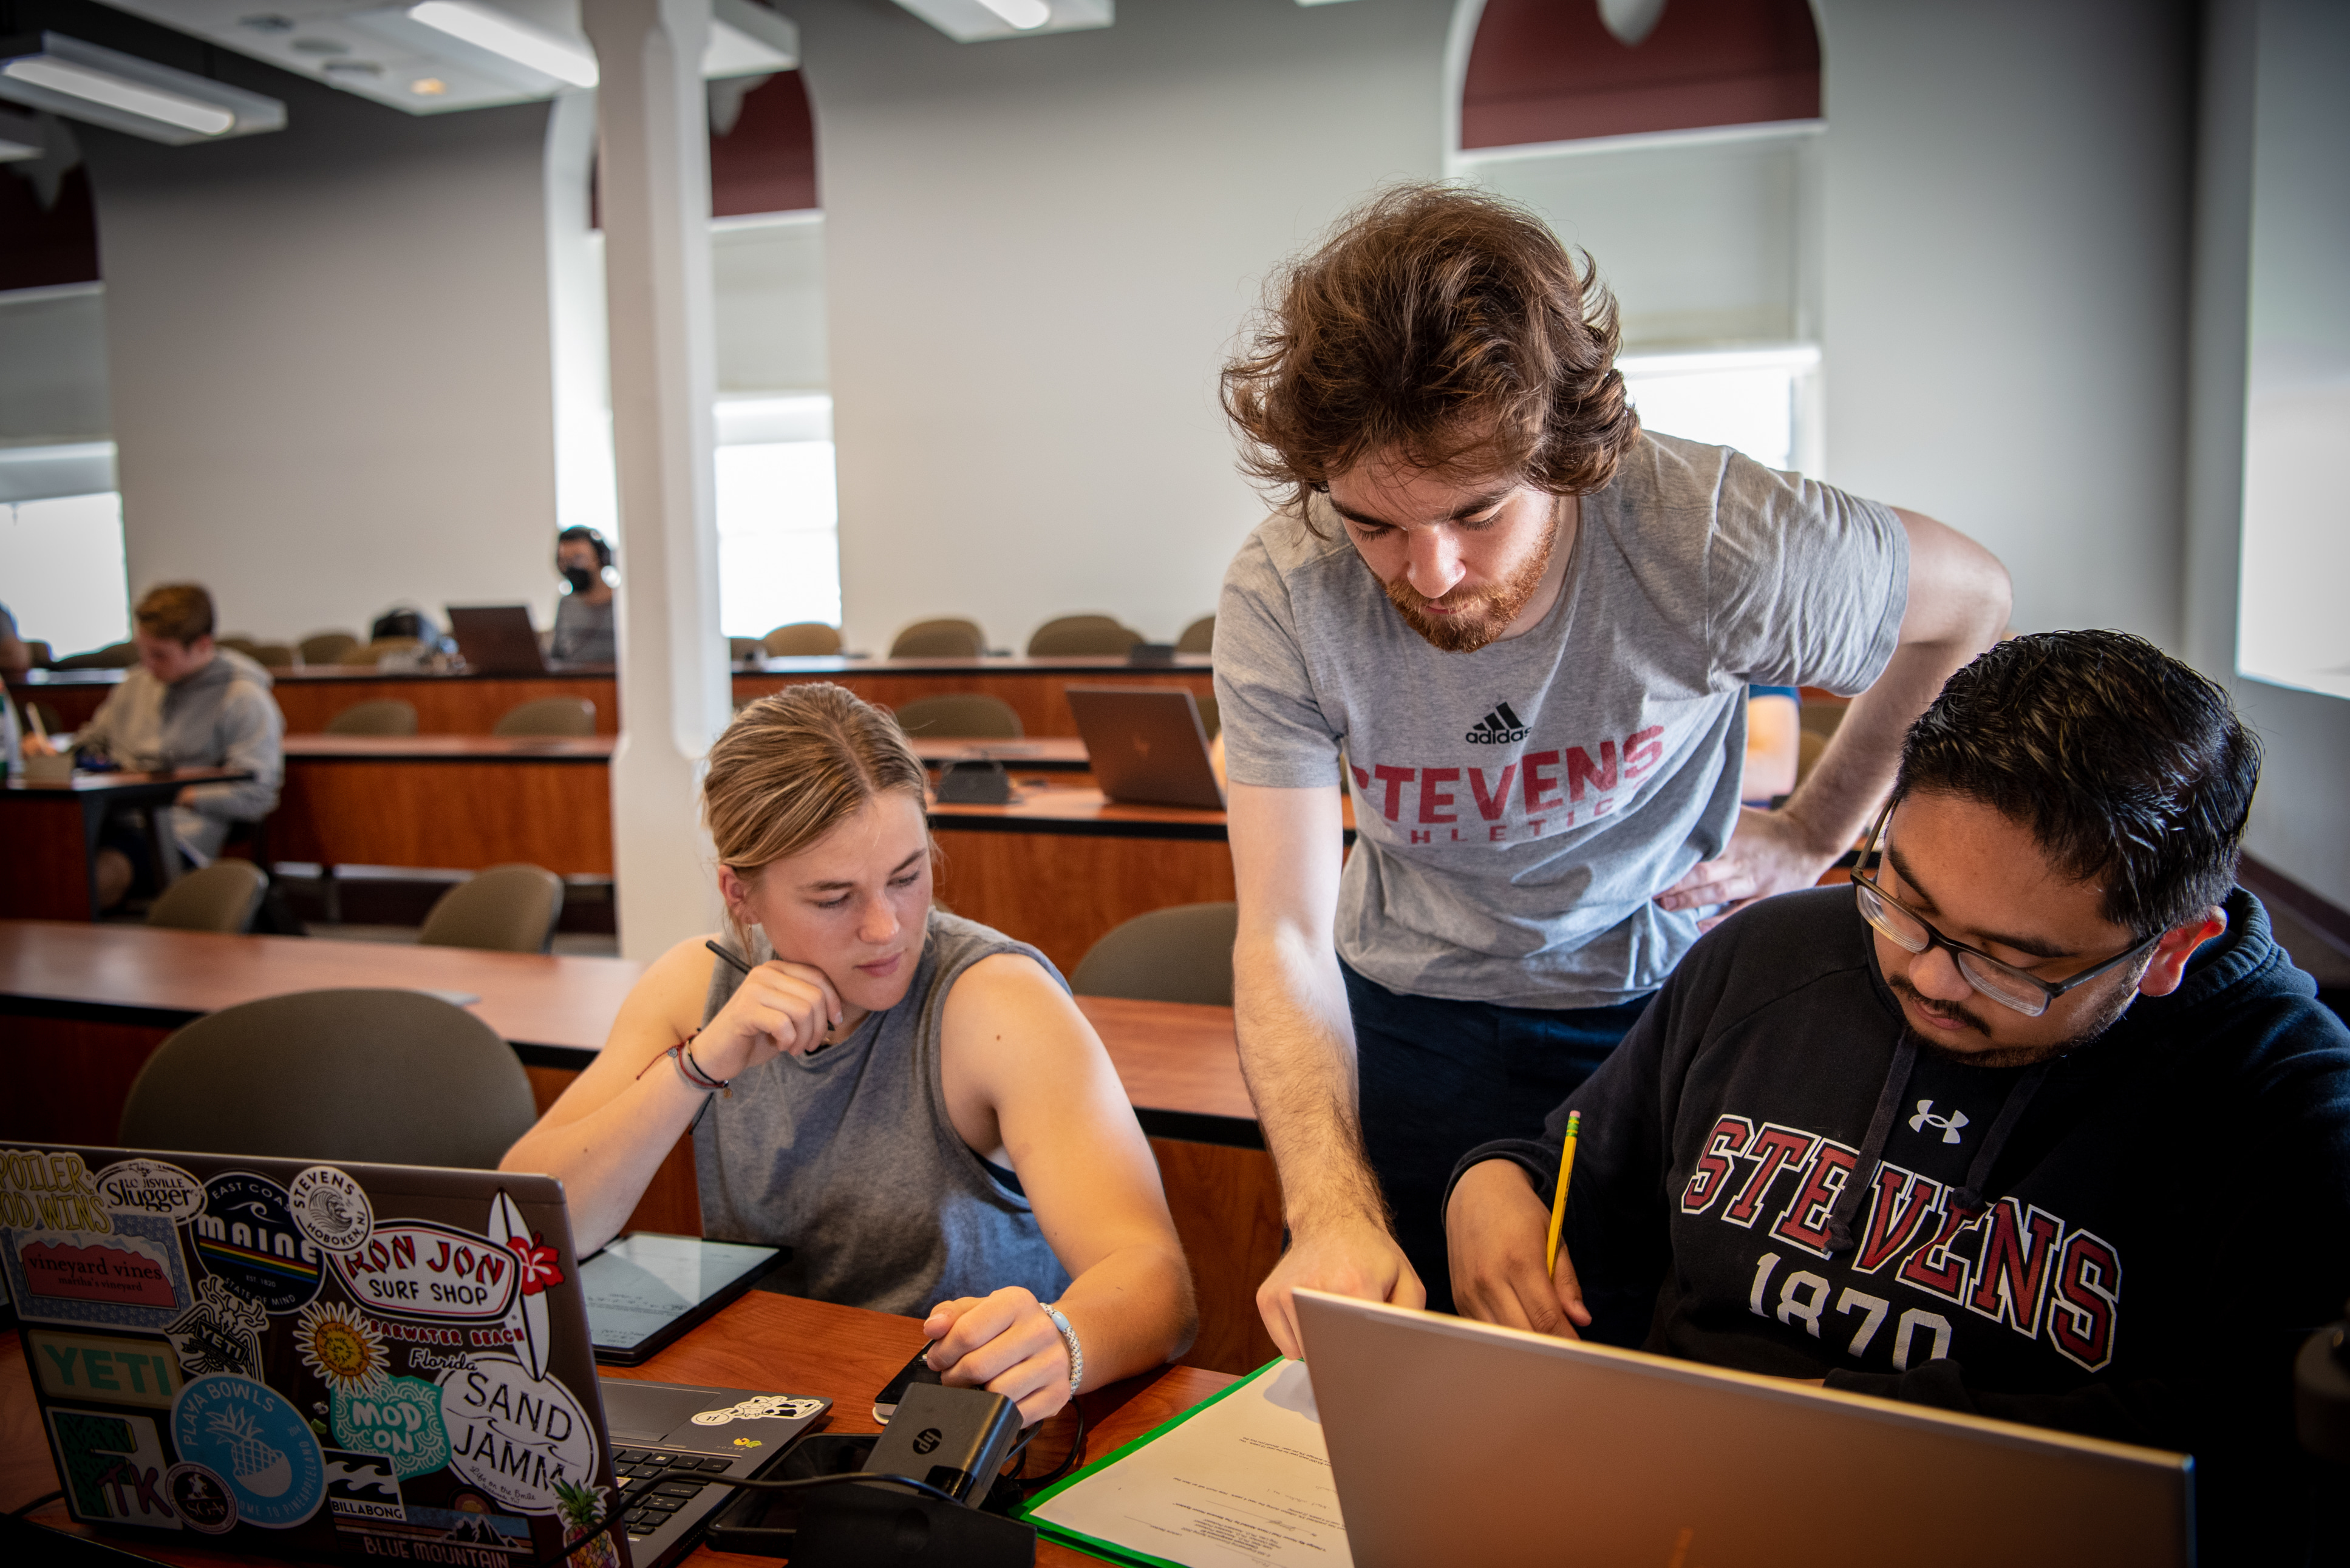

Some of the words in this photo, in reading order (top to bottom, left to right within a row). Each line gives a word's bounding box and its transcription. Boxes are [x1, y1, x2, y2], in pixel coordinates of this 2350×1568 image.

[1466, 727, 1531, 745] adidas
[1401, 783, 1640, 844] HLETIC
[106, 1179, 191, 1213] Slugger
[211, 1182, 243, 1200] EAST
[295, 1171, 355, 1209] STEVENS
[36, 1193, 111, 1234] WINS
[307, 1223, 364, 1246] HOBOKEN,
[357, 1210, 367, 1226] NJ
[197, 1214, 318, 1264] MAINE
[1681, 1114, 2122, 1373] STEVENS
[28, 1254, 109, 1278] vineyard
[114, 1261, 163, 1280] vines
[344, 1235, 416, 1280] RON
[426, 1240, 506, 1287] JON
[59, 1276, 100, 1288] martha's
[101, 1280, 143, 1292] vineyard
[224, 1277, 251, 1300] STATE
[255, 1295, 268, 1306] OF
[271, 1294, 296, 1306] MIND
[261, 1278, 276, 1288] 1820
[369, 1279, 419, 1300] SURF
[430, 1283, 488, 1306] SHOP
[1749, 1252, 1952, 1371] 1870
[200, 1325, 243, 1360] YETI
[472, 1328, 526, 1345] BEACH
[42, 1344, 173, 1396] YETI
[411, 1349, 478, 1371] Florida
[183, 1393, 209, 1446] PLAYA
[206, 1381, 275, 1413] BOWLS
[352, 1400, 422, 1433] MOD
[463, 1372, 572, 1442] SAND
[373, 1429, 415, 1454] ON
[267, 1505, 281, 1518] TO
[282, 1441, 317, 1515] PINEAPPLELAND
[470, 1465, 487, 1483] Life
[489, 1481, 497, 1489] on
[500, 1484, 512, 1496] the
[186, 1501, 225, 1518] SGA
[332, 1501, 403, 1519] BILLABONG
[363, 1535, 410, 1560] BLUE
[412, 1542, 510, 1568] MOUNTAIN
